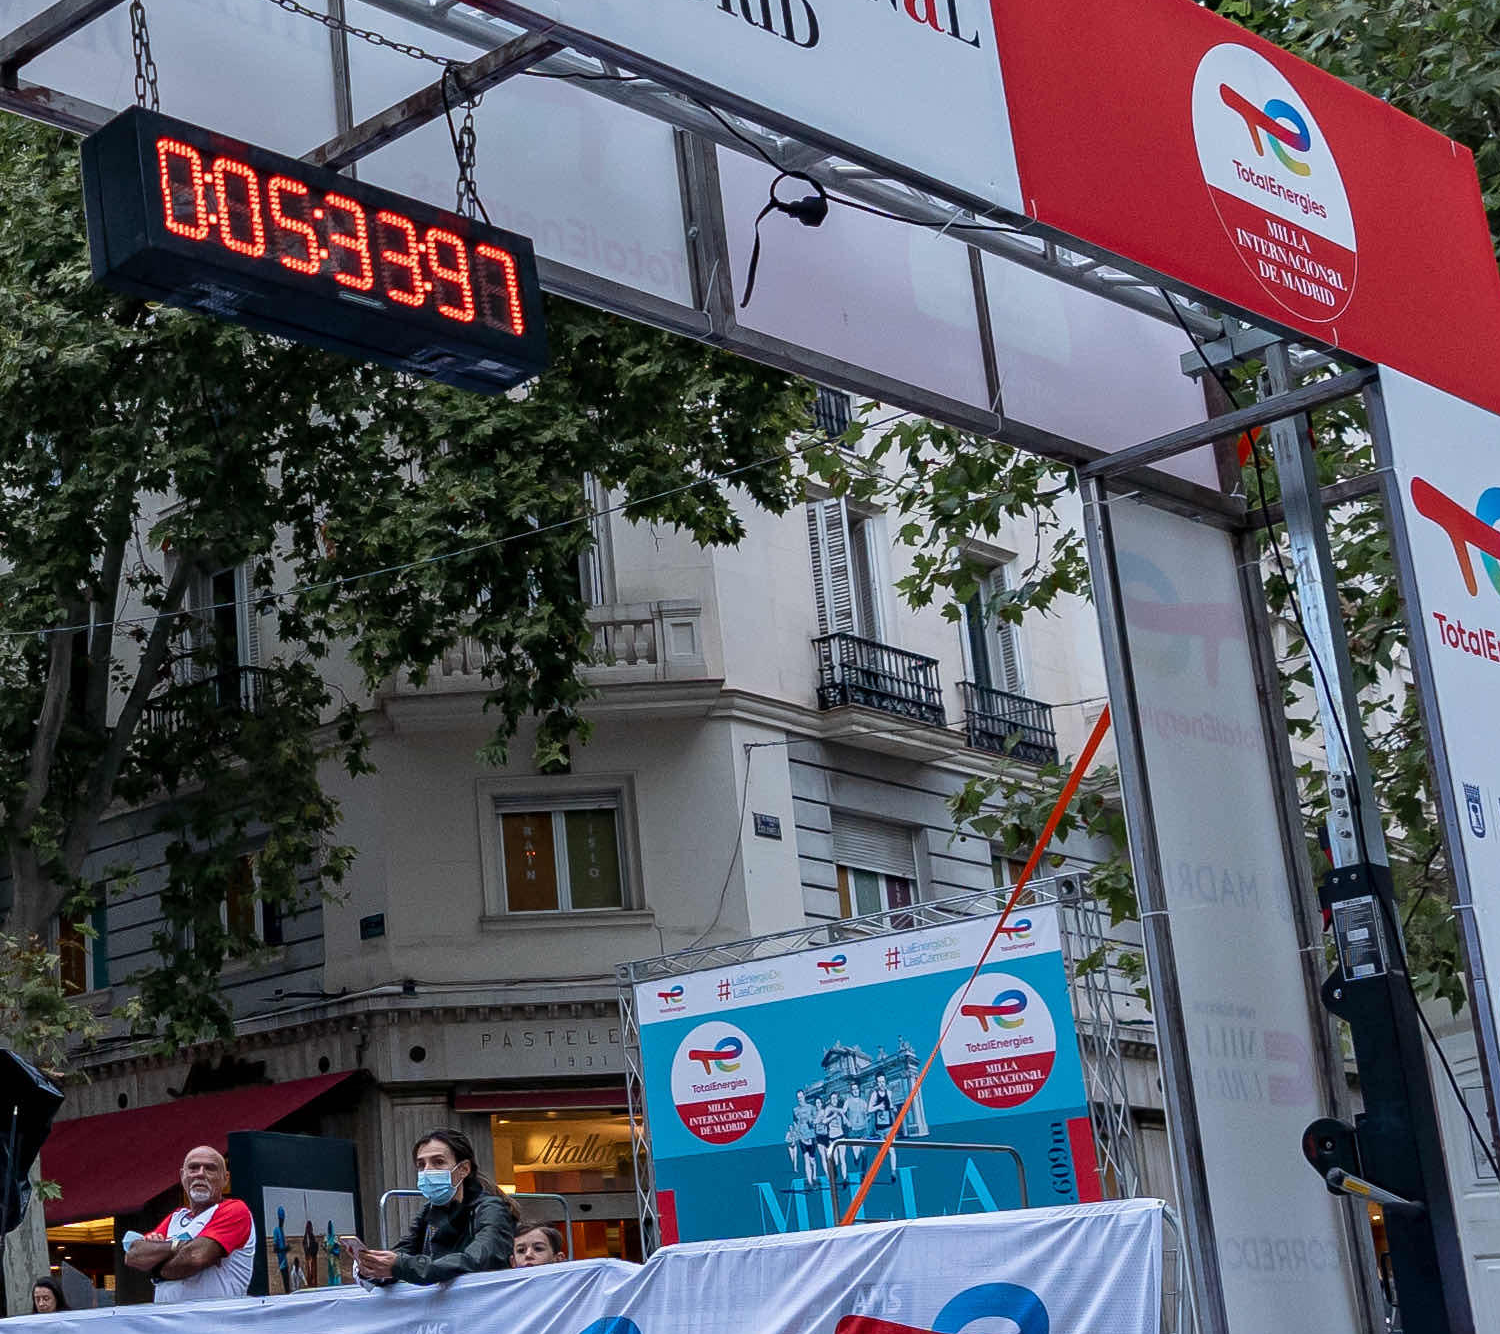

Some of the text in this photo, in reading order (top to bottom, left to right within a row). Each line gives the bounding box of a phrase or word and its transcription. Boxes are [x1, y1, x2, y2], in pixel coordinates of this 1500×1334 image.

[1233, 160, 1328, 218] TotalEnergies
[1266, 219, 1312, 254] MILLA
[1259, 259, 1335, 307] DE MADRID
[481, 1027, 636, 1050] PASTELE
[964, 1034, 1035, 1053] TotalEnergies
[985, 1060, 1019, 1074] MILLA
[691, 1077, 748, 1094] TotalEnergies
[977, 1083, 1034, 1099] DE MADRID
[708, 1101, 735, 1113] MILLA
[700, 1121, 747, 1136] DE MADRID
